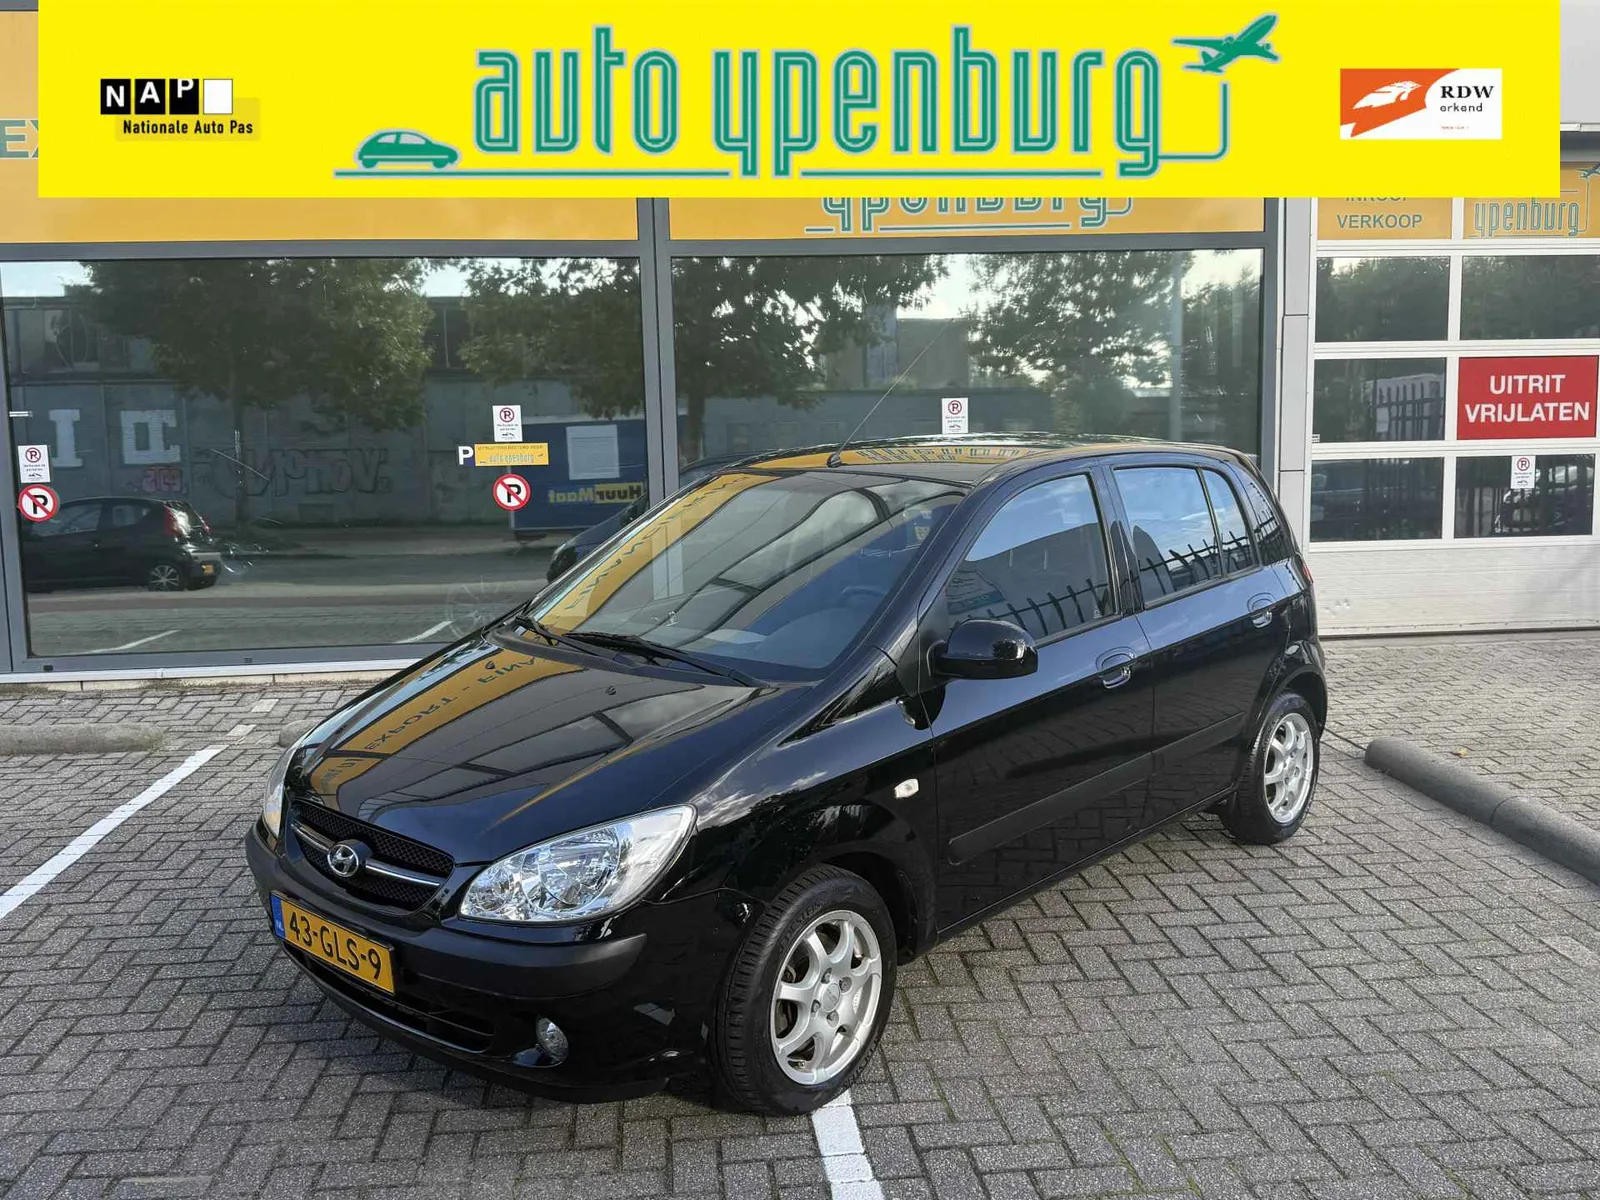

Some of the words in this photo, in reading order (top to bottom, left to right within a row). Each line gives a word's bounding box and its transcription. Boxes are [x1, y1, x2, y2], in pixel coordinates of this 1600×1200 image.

[1336, 214, 1423, 229] VERKOOP
[1489, 374, 1566, 394] UITRIT
[1464, 401, 1590, 423] VRIJLATEN
[288, 910, 382, 981] 43-GLS-9
